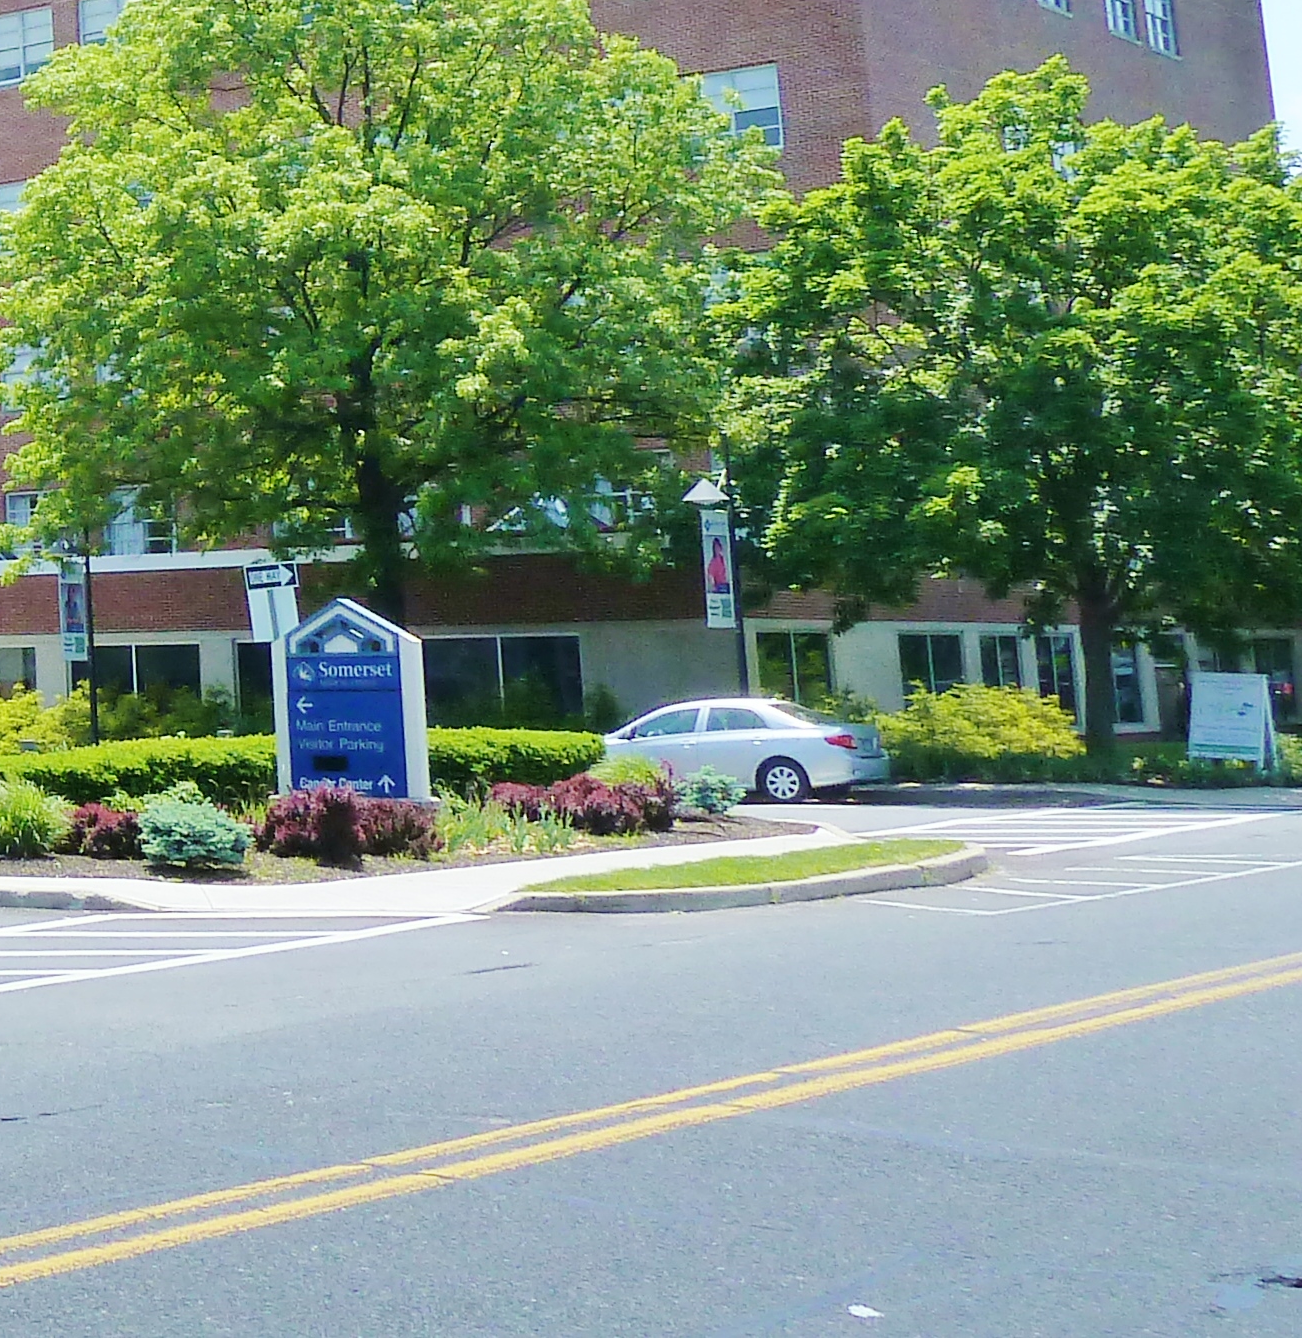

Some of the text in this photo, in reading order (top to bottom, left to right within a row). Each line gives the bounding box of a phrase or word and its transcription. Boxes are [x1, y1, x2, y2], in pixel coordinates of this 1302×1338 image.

[319, 662, 392, 677] Somerset
[296, 720, 382, 732] Main Entrance
[298, 738, 384, 753] Visitor Parking
